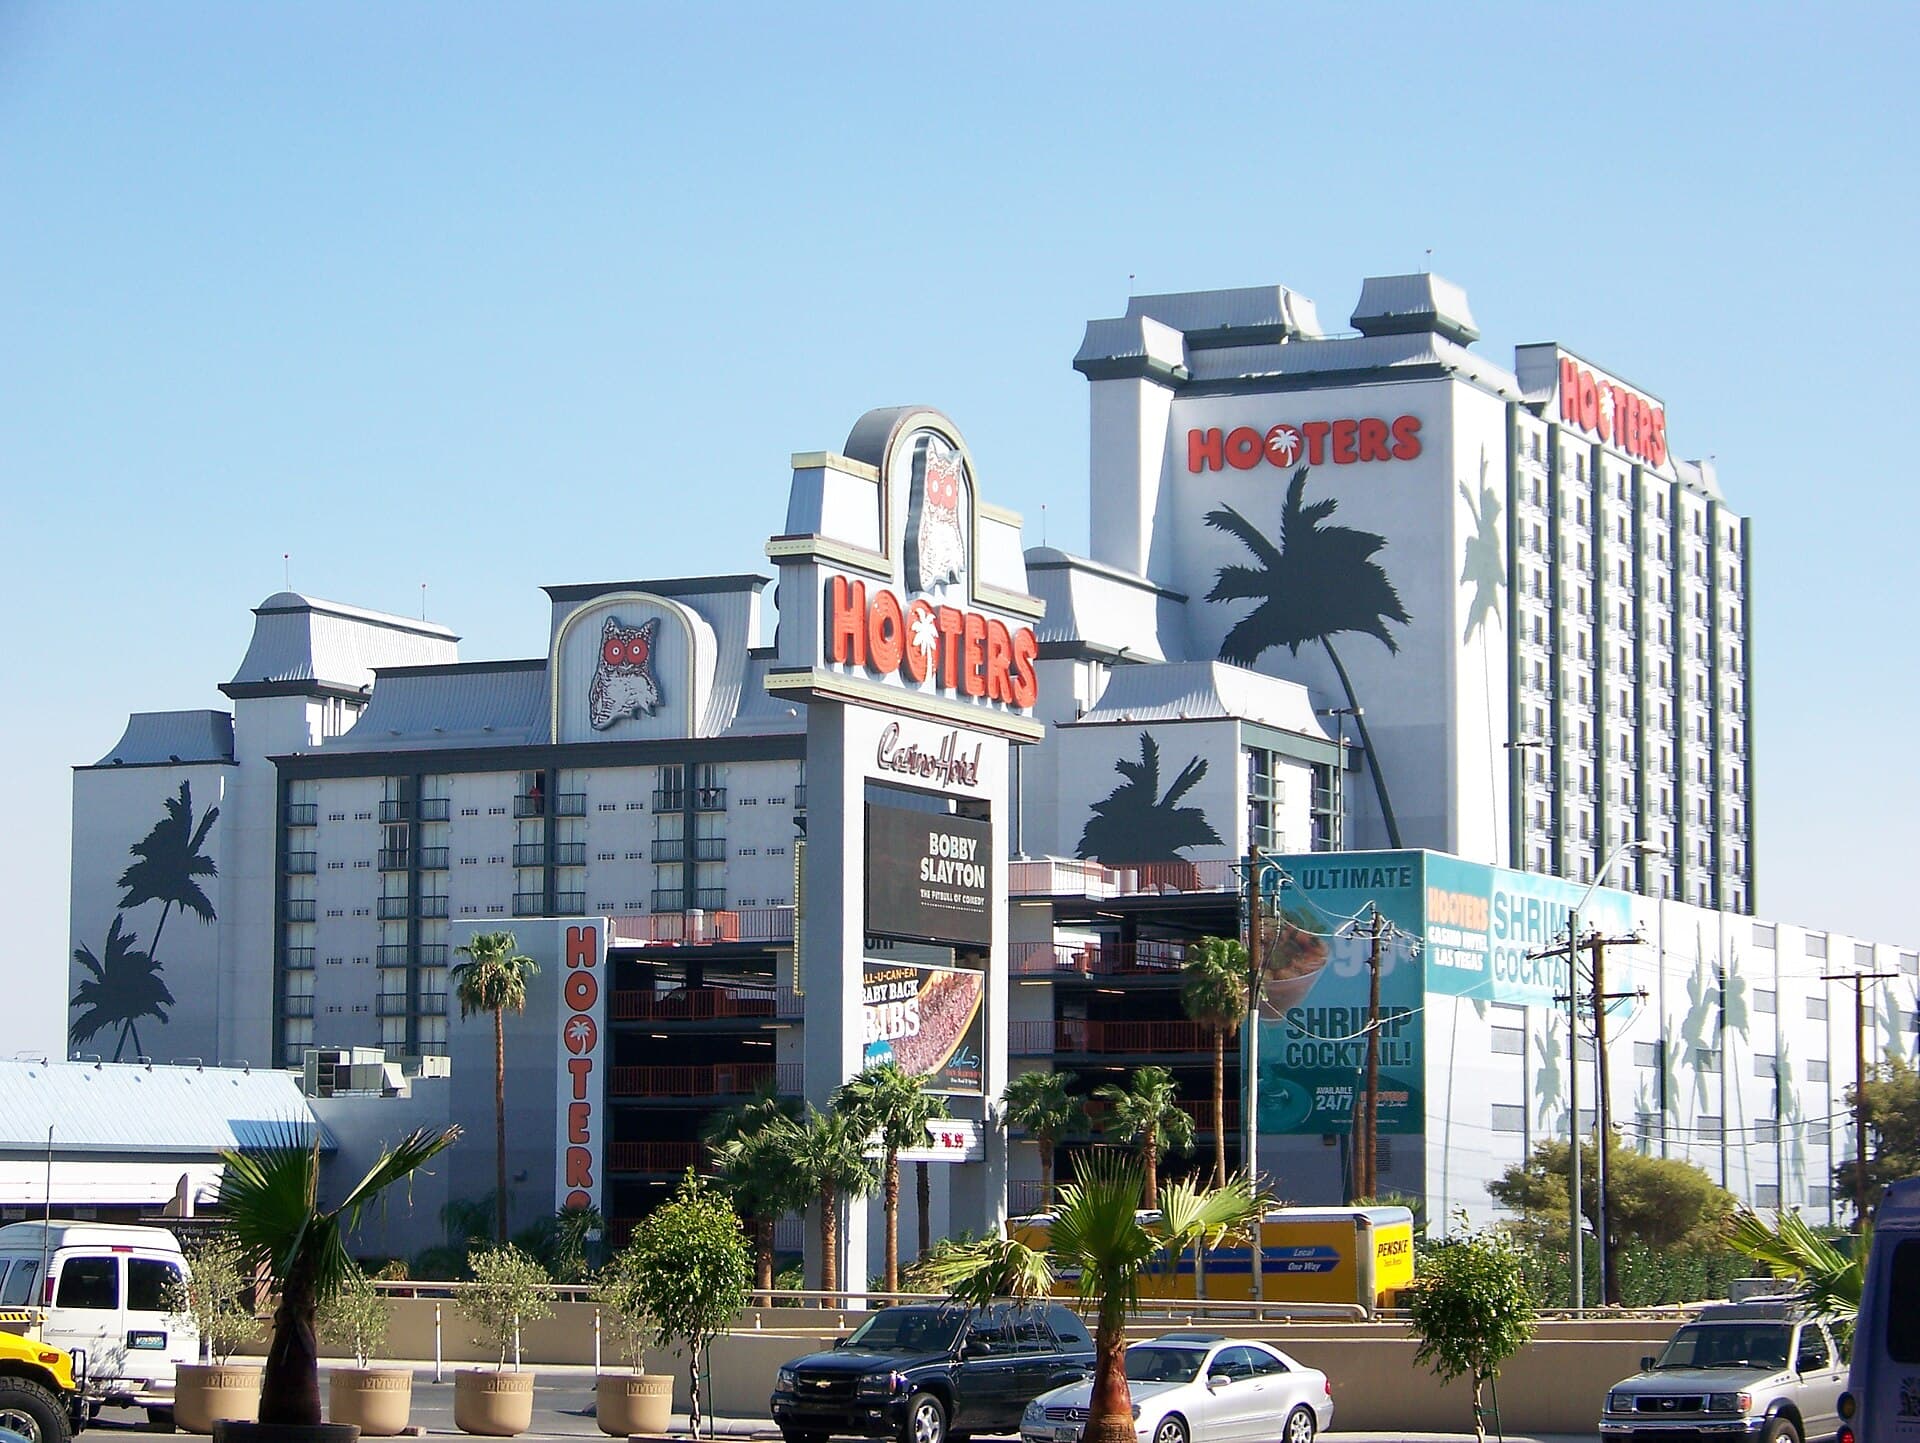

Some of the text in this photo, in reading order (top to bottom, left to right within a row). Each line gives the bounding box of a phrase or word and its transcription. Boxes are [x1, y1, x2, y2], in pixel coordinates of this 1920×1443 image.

[1559, 356, 1665, 469] HOOTERS
[1187, 415, 1422, 473] HOOTERS
[825, 574, 1040, 709] HOOTERS
[877, 721, 982, 788] Casino Hotel
[929, 831, 978, 862] BOBBY
[919, 856, 986, 889] SLAYTON
[1258, 865, 1413, 891] HE ULTIMATE
[919, 888, 931, 899] THE
[953, 893, 962, 903] OF
[962, 894, 985, 907] COMEDY
[1428, 887, 1489, 931] HOOTERS
[1493, 890, 1572, 946] SHRIM
[1434, 946, 1485, 973] LAS VEGAS
[1494, 945, 1573, 991] COCKTAI
[863, 967, 918, 984] LL-U-CAN-EAT
[889, 979, 920, 1000] BACK
[863, 1001, 921, 1045] RIBS
[1285, 1006, 1412, 1040] SHRIMP
[1315, 1095, 1353, 1111] 24/7
[1316, 1085, 1353, 1095] AVAILABLE
[1293, 1247, 1316, 1257] Local
[1377, 1240, 1408, 1257] PENSKE
[1288, 1262, 1321, 1274] One Way
